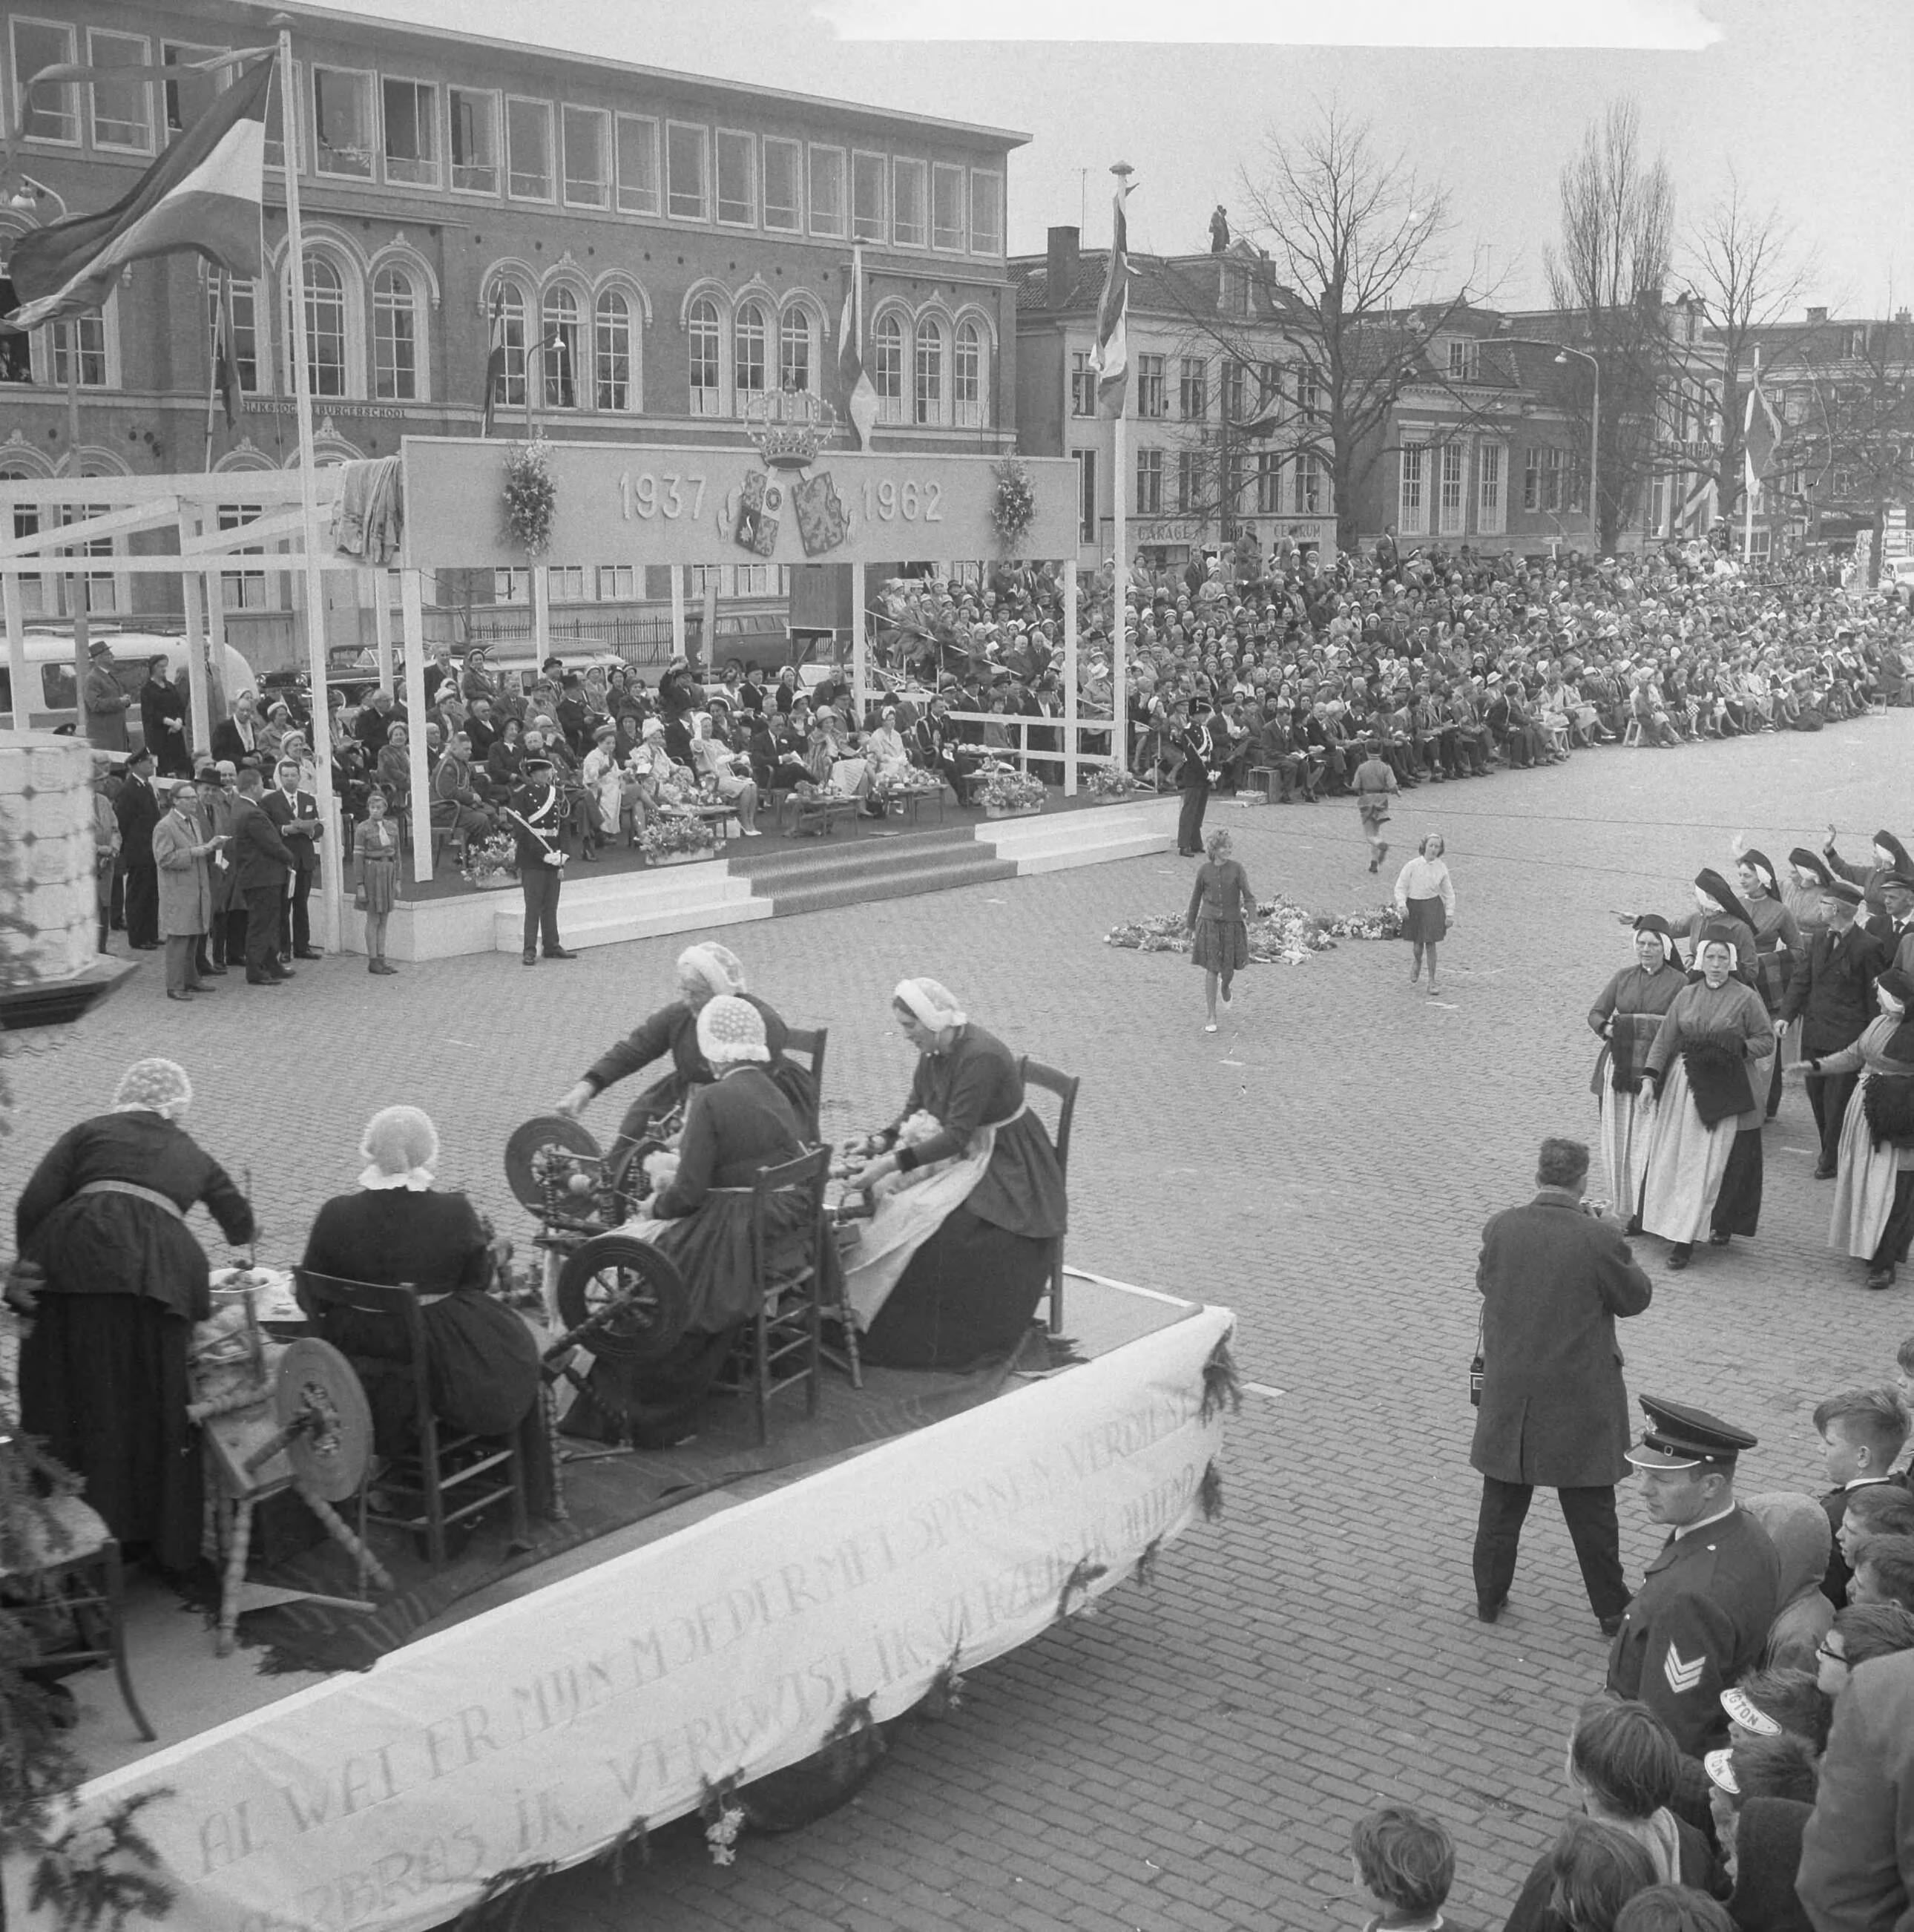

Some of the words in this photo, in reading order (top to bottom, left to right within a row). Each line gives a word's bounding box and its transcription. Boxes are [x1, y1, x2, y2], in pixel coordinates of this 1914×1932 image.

[618, 470, 708, 521] 1937
[861, 478, 944, 521] 1962
[1137, 525, 1189, 541] GARAGE
[1273, 524, 1321, 538] CERUM
